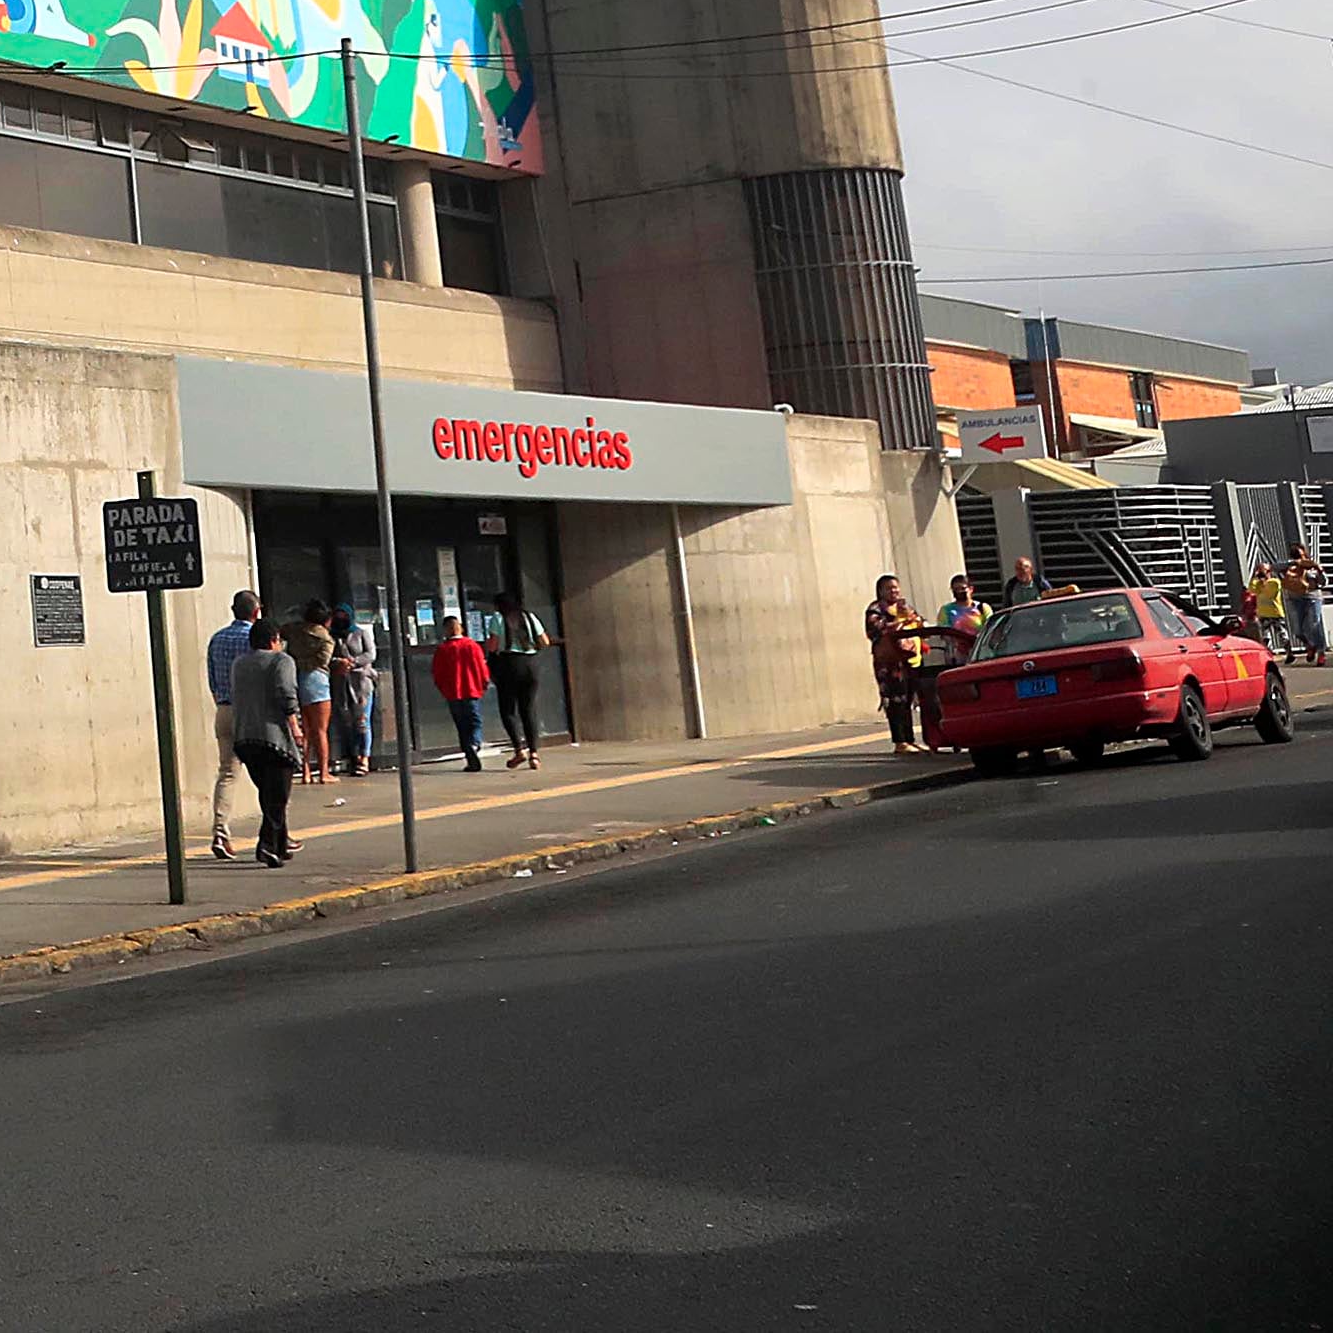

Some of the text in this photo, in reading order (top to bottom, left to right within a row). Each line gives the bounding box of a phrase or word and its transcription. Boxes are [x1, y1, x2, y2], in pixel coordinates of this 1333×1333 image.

[961, 414, 1036, 428] AMBULANCIAS
[433, 417, 632, 479] emergencias
[108, 504, 185, 528] PARADA
[114, 524, 194, 547] DE TAXI
